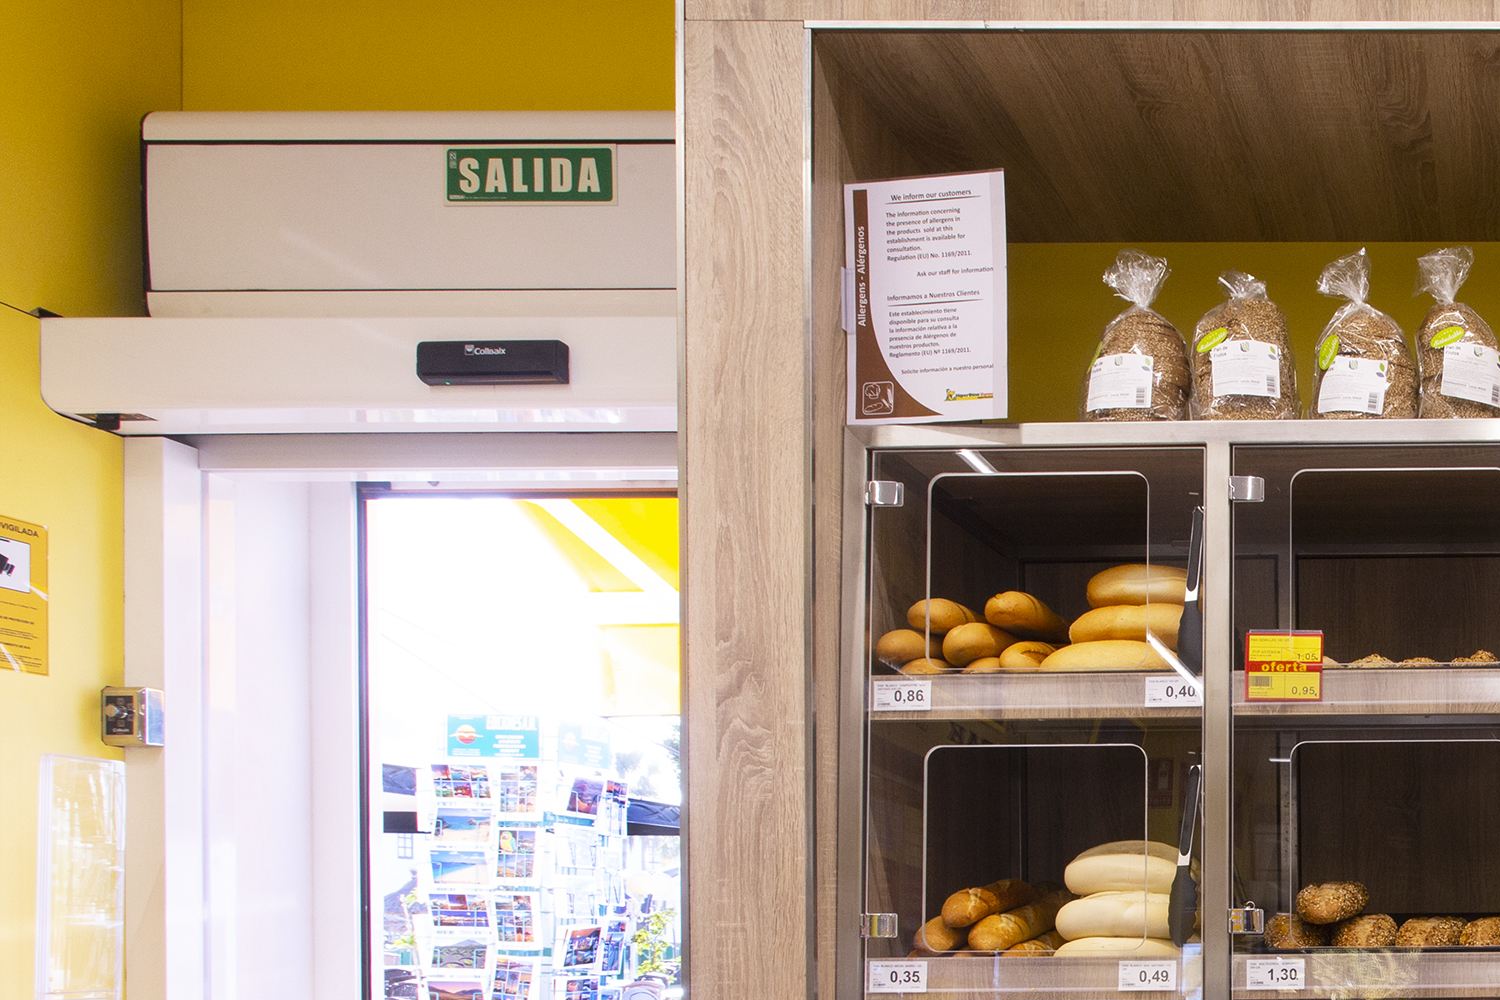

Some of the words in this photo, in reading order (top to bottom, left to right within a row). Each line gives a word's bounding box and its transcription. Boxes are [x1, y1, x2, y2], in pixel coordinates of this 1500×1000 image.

[459, 157, 600, 193] SALIDA
[938, 189, 971, 198] customers
[930, 207, 961, 215] concerning
[929, 217, 954, 225] allergens
[887, 236, 925, 244] establishment
[857, 226, 866, 275] Alérgenos
[887, 245, 922, 253] consultation.
[887, 254, 916, 262] Regulation
[941, 250, 972, 258] 1169/2011.
[961, 266, 993, 274] information
[929, 291, 955, 299] Nuestros
[957, 289, 980, 297] Clientes
[858, 281, 867, 327] Allergens
[901, 308, 942, 317] establecimiento
[889, 318, 916, 326] disponible
[895, 325, 926, 333] información
[923, 332, 949, 340] Alérgenos
[913, 341, 940, 349] productos.
[889, 350, 920, 358] Reglamento
[920, 366, 948, 374] información
[1261, 662, 1307, 672] oferta
